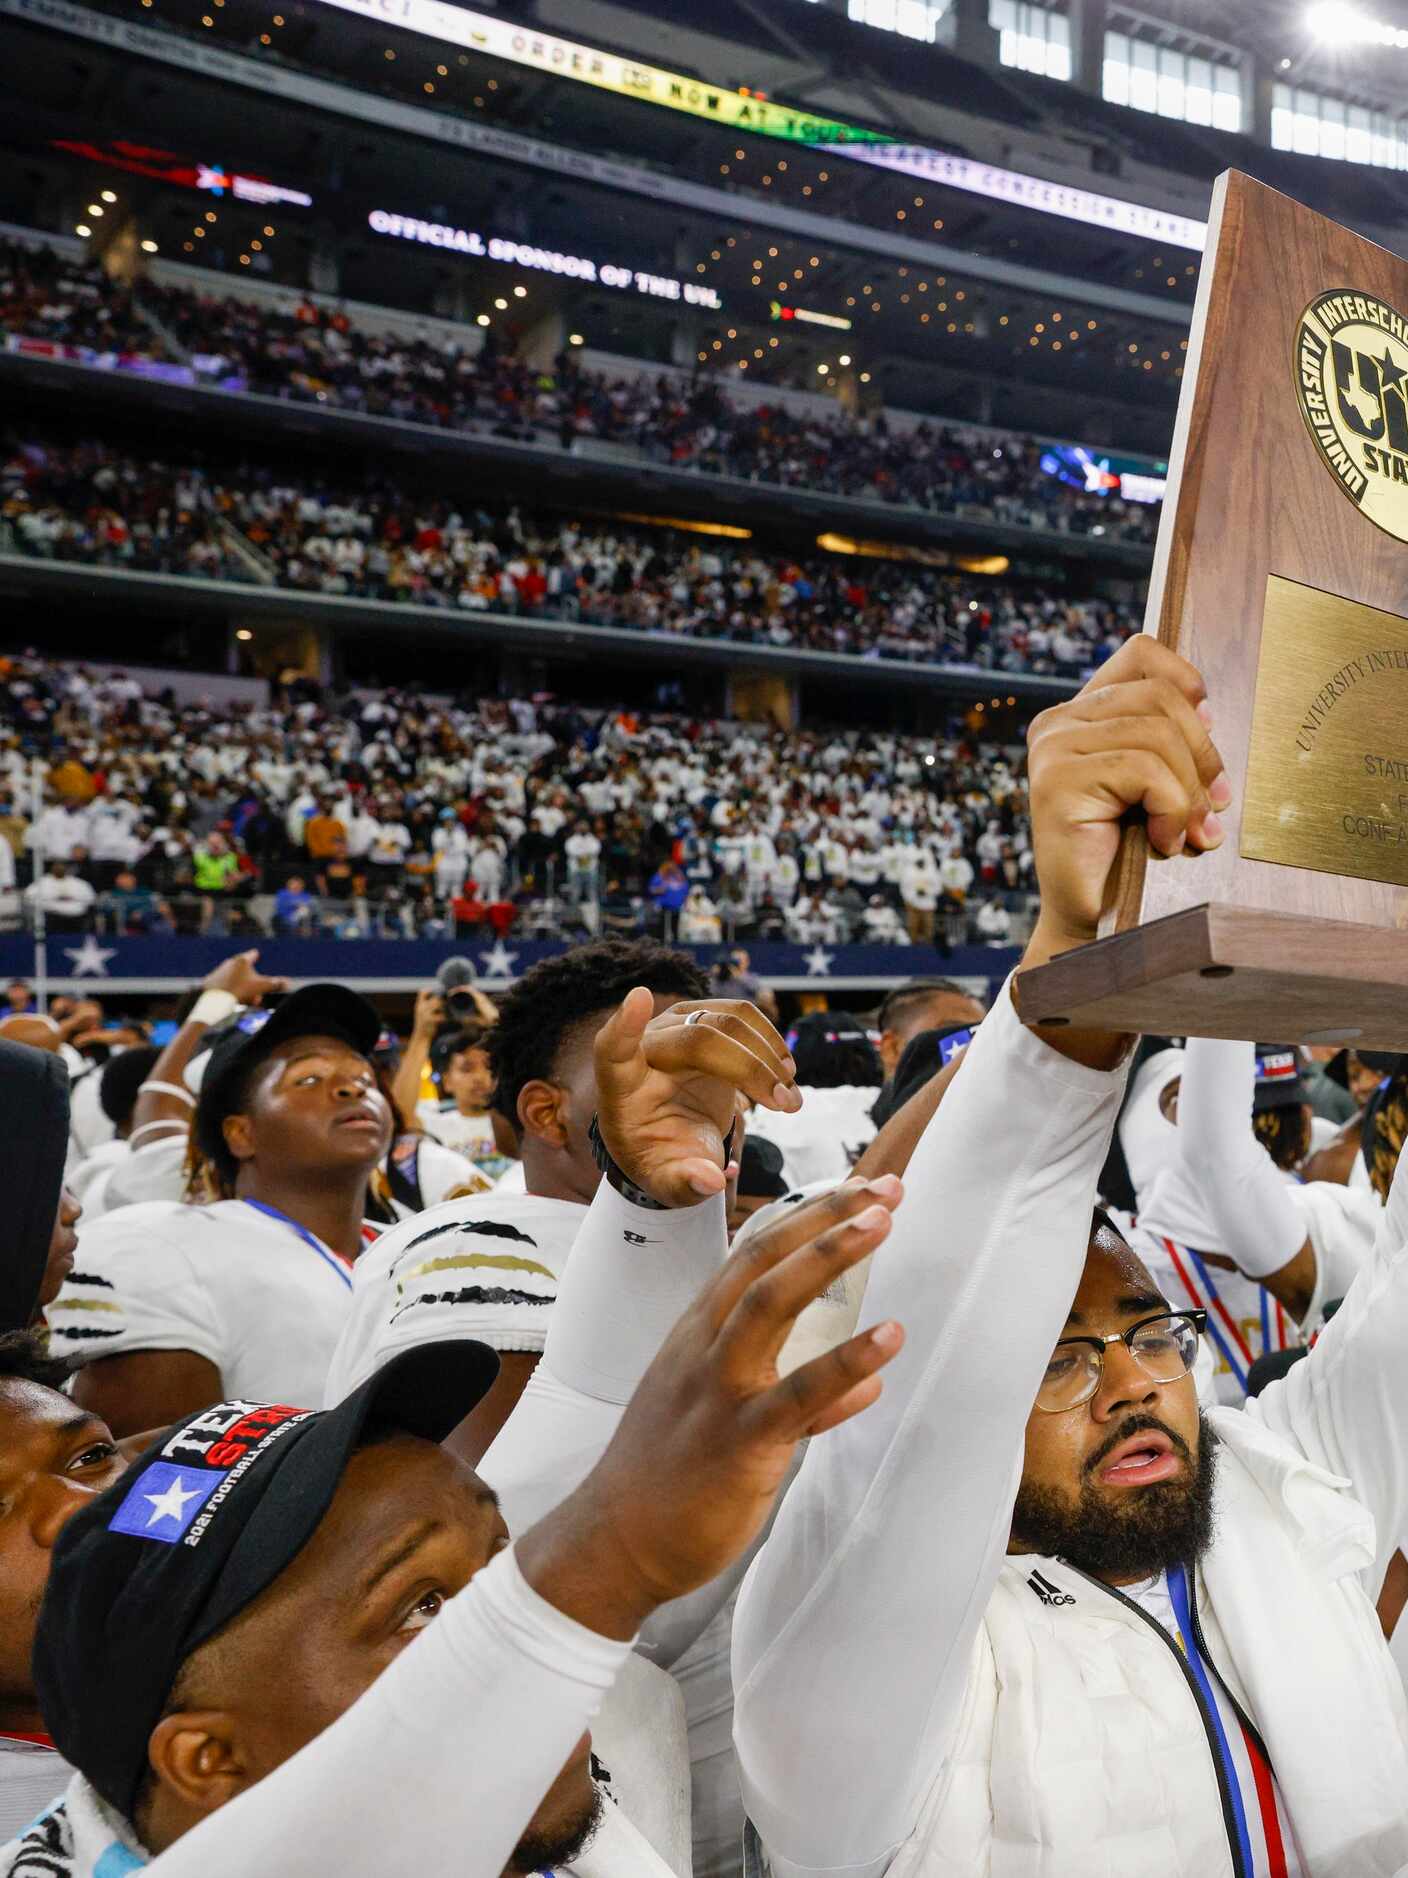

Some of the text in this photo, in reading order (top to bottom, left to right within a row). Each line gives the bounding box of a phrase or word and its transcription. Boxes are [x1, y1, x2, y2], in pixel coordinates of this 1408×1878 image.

[738, 104, 768, 125] AT
[368, 209, 486, 256] OFFICIAL
[488, 237, 598, 283] SPONSOR
[600, 263, 634, 289] OF
[635, 271, 681, 300] THE
[1300, 332, 1366, 498] UNIVERSITY
[1295, 660, 1365, 753] UNIVERSITY
[160, 1399, 272, 1459] TEX
[184, 1512, 214, 1549] 2021
[206, 1447, 264, 1514] FOOTBALL
[256, 1420, 298, 1450] STATE
